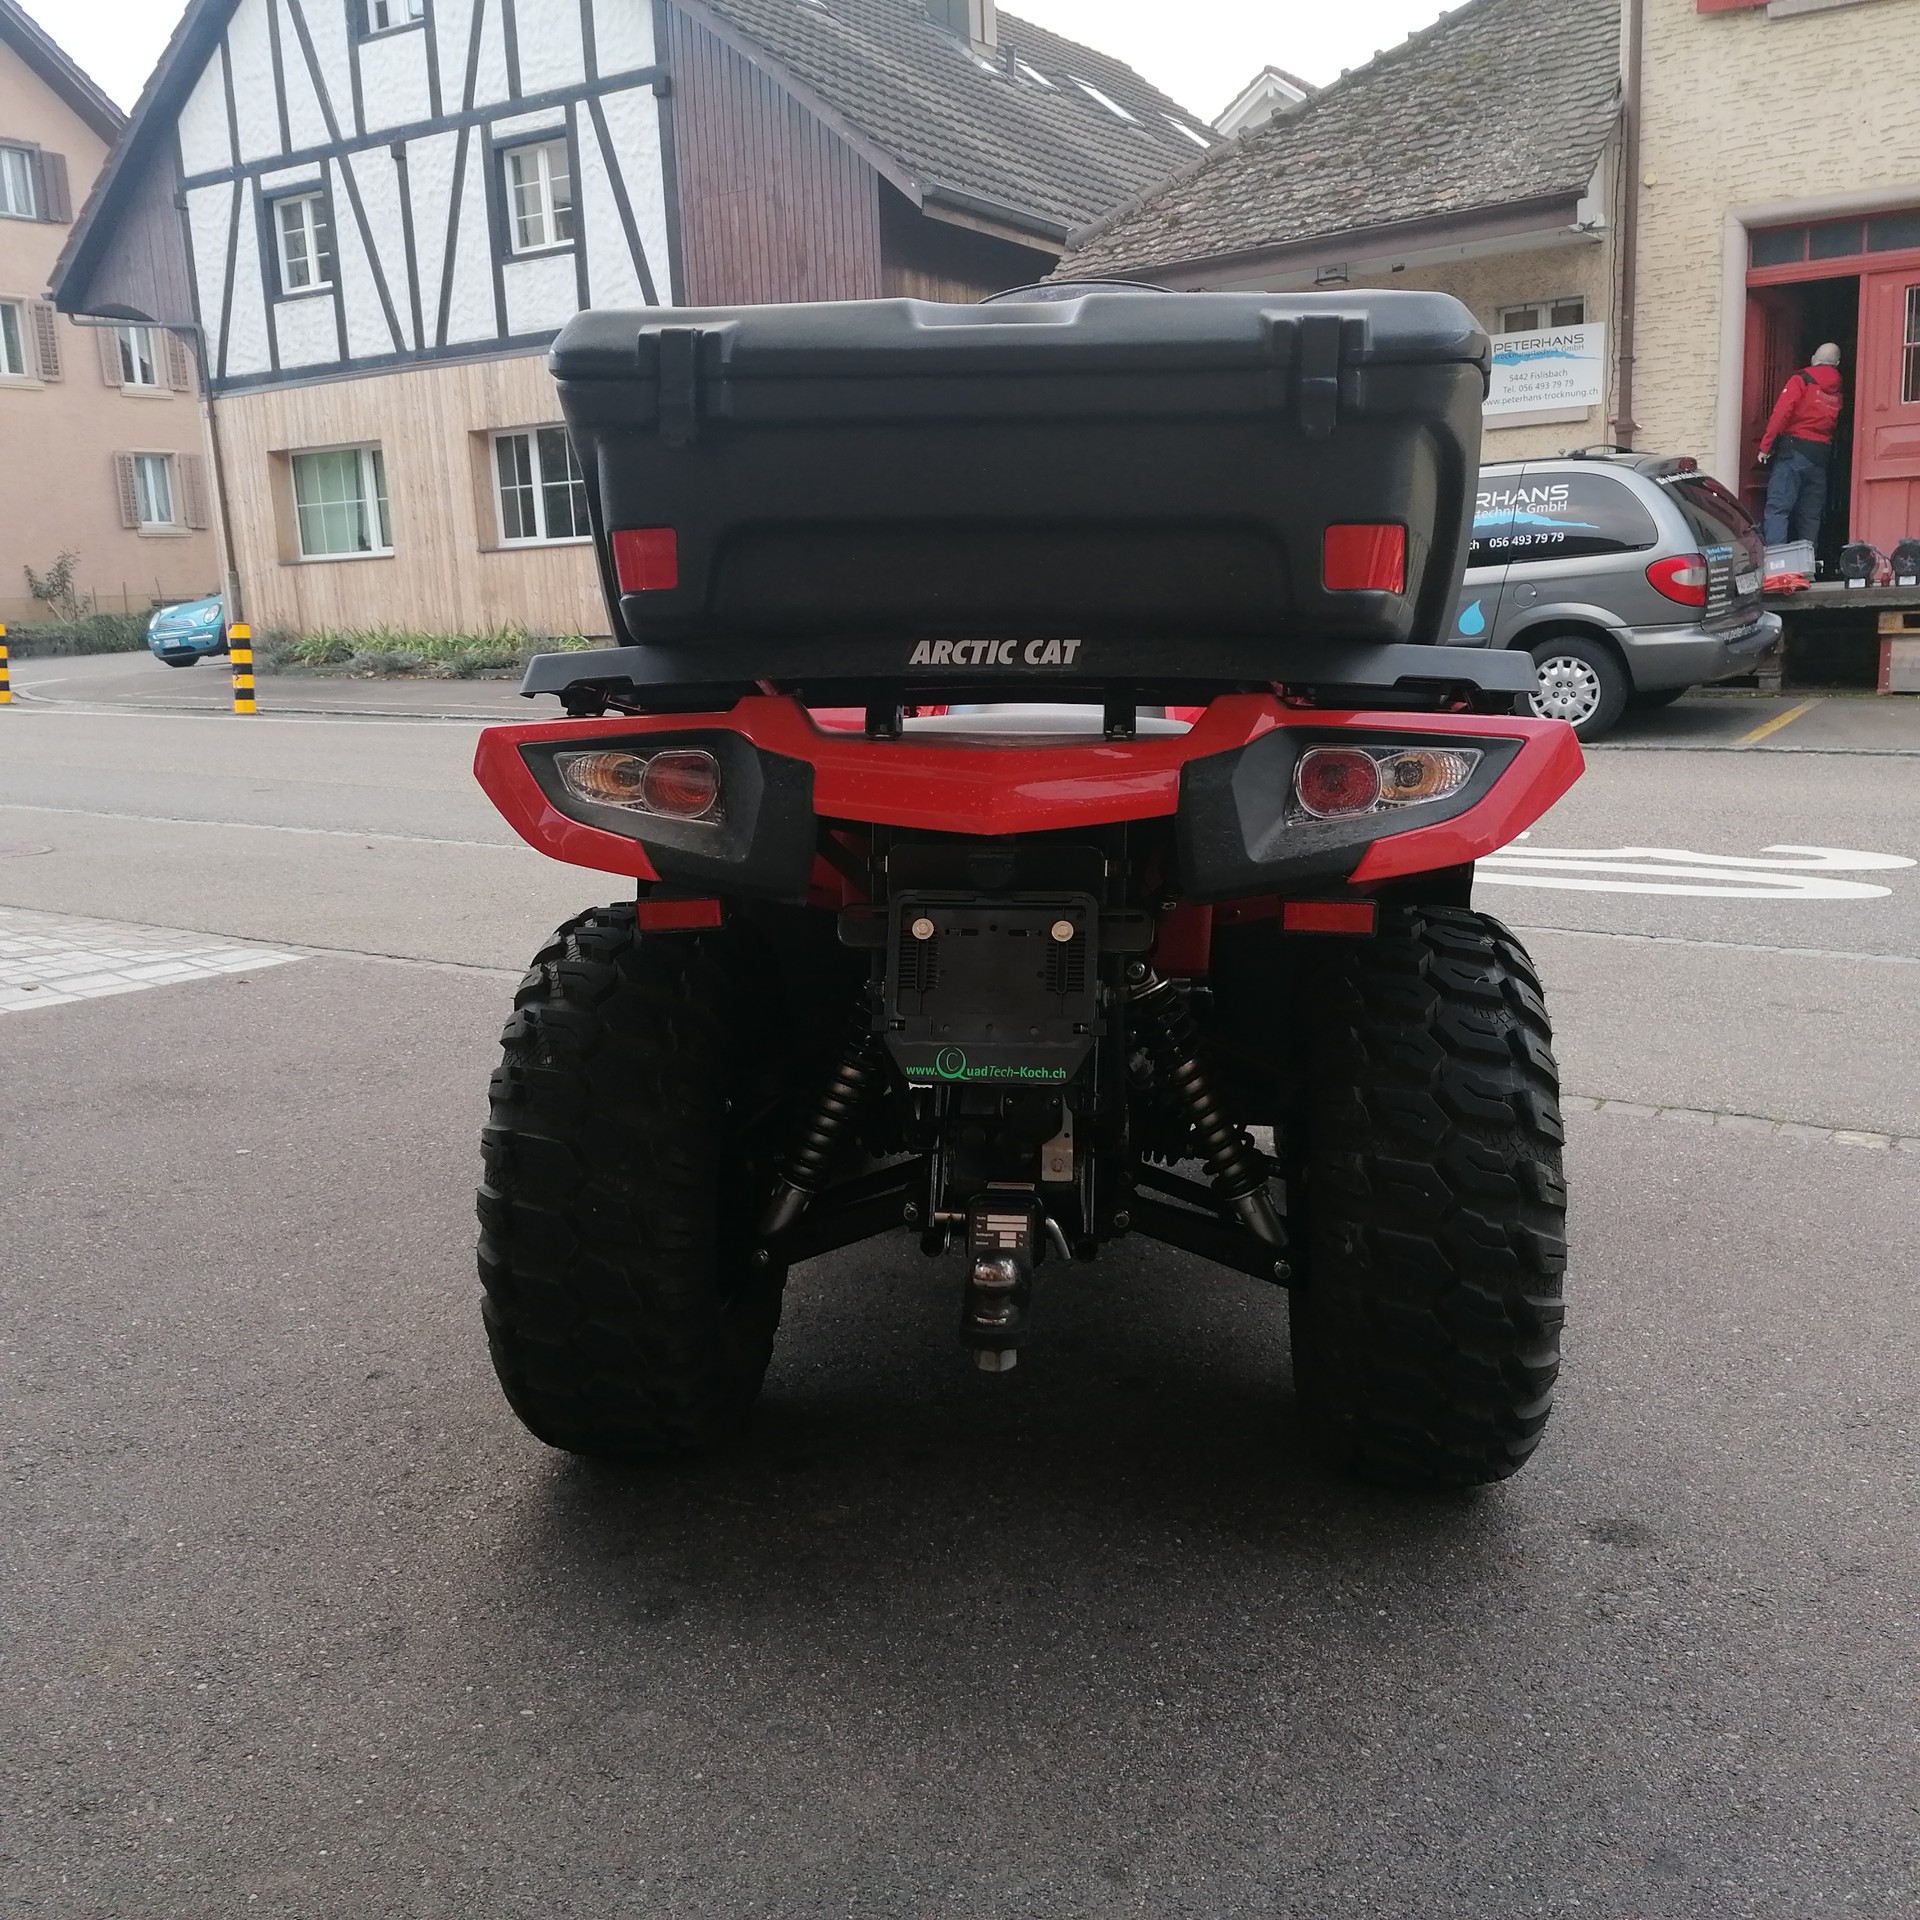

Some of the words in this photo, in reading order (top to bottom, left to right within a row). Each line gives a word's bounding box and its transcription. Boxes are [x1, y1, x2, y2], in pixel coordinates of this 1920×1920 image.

[1493, 333, 1584, 353] PETERHANS
[1561, 343, 1584, 353] GmbH
[1509, 372, 1528, 382] 5442
[1530, 368, 1568, 380] Fislisbach
[1503, 385, 1517, 394] Tel.
[1519, 383, 1533, 392] 056
[1535, 381, 1550, 390] 493
[1552, 380, 1562, 389] 79
[1564, 378, 1574, 388] 79
[1476, 483, 1570, 508] RHANS
[1475, 504, 1522, 519] technik
[1526, 500, 1567, 514] GmbH
[1489, 537, 1509, 548] 056
[1511, 534, 1532, 546] 493
[1534, 533, 1548, 544] 79
[1551, 531, 1565, 543] 79
[909, 639, 1018, 665] ARCTIC
[1024, 639, 1082, 665] CAT
